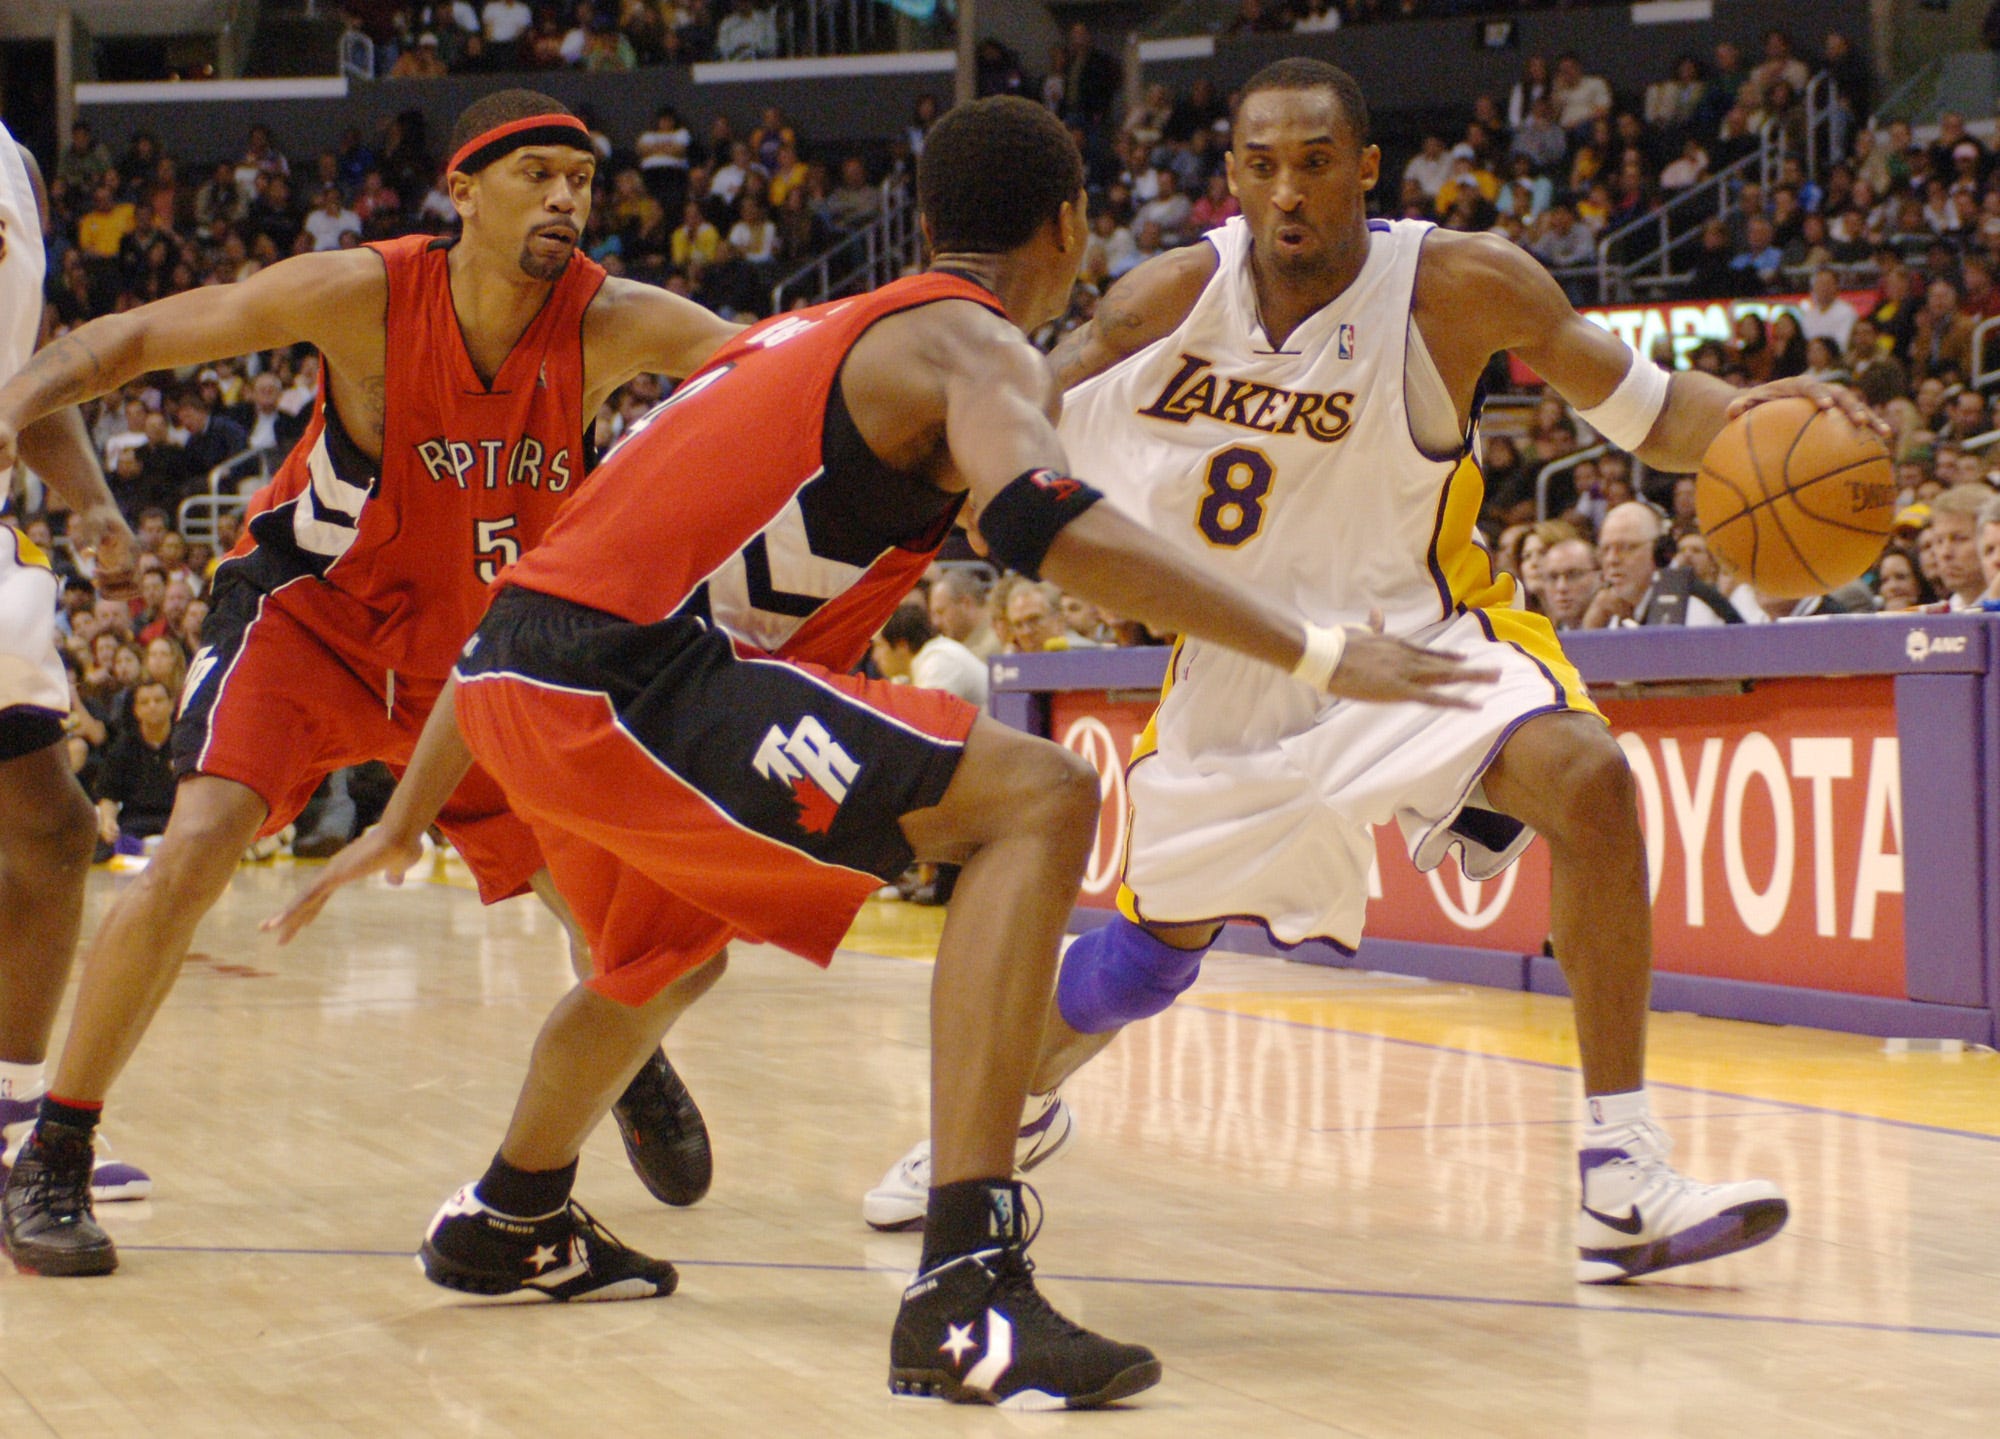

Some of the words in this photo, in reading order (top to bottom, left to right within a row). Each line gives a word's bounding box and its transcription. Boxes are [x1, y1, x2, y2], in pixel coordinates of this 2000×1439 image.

[1137, 353, 1356, 442] LAKERS
[414, 433, 570, 493] RPTRS
[1193, 443, 1277, 549] 8
[474, 515, 521, 584] 5
[1616, 731, 1904, 941] OYOTA
